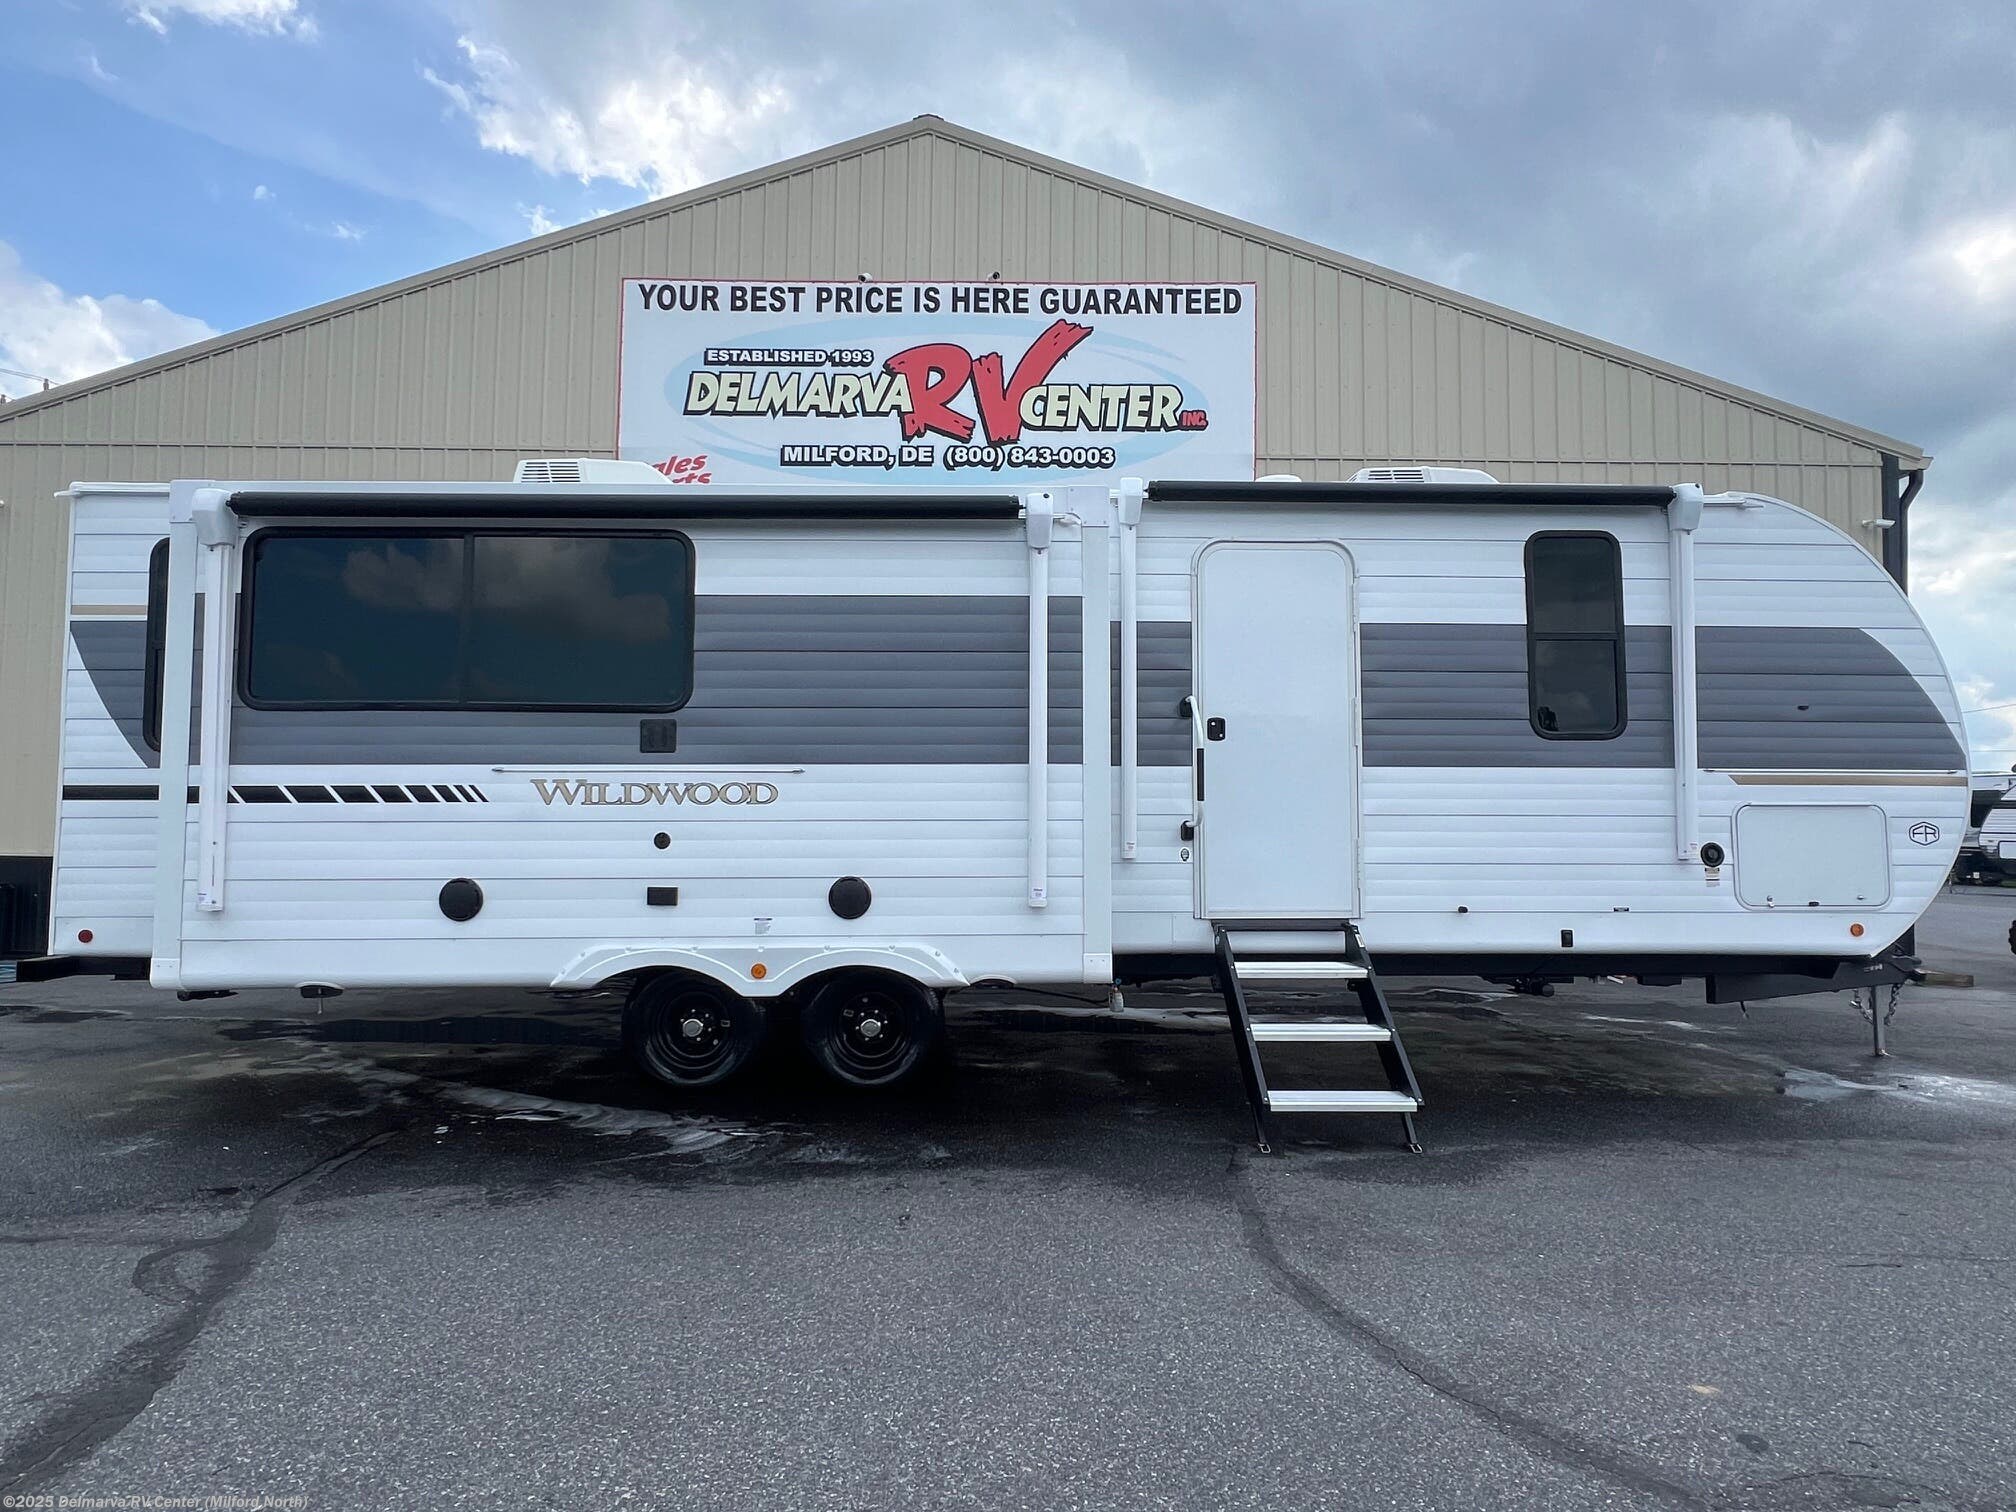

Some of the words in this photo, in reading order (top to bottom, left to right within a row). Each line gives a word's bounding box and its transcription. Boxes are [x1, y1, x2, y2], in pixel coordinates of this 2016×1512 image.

[638, 283, 719, 311] YOUR
[730, 286, 806, 312] BEST
[815, 286, 902, 313] PRICE
[914, 287, 941, 313] IS
[952, 287, 1029, 313] HERE
[1040, 288, 1242, 314] GUARANTEED
[706, 350, 827, 363] ESTABLISHED
[832, 351, 873, 363] 1993
[686, 371, 914, 416] DELMARVA
[883, 319, 1093, 443] RV
[1019, 385, 1183, 429] CENTER
[783, 446, 894, 466] MILFORD,
[902, 447, 933, 463] DE
[946, 446, 1003, 468] (800)
[1010, 448, 1115, 466] 843-0003
